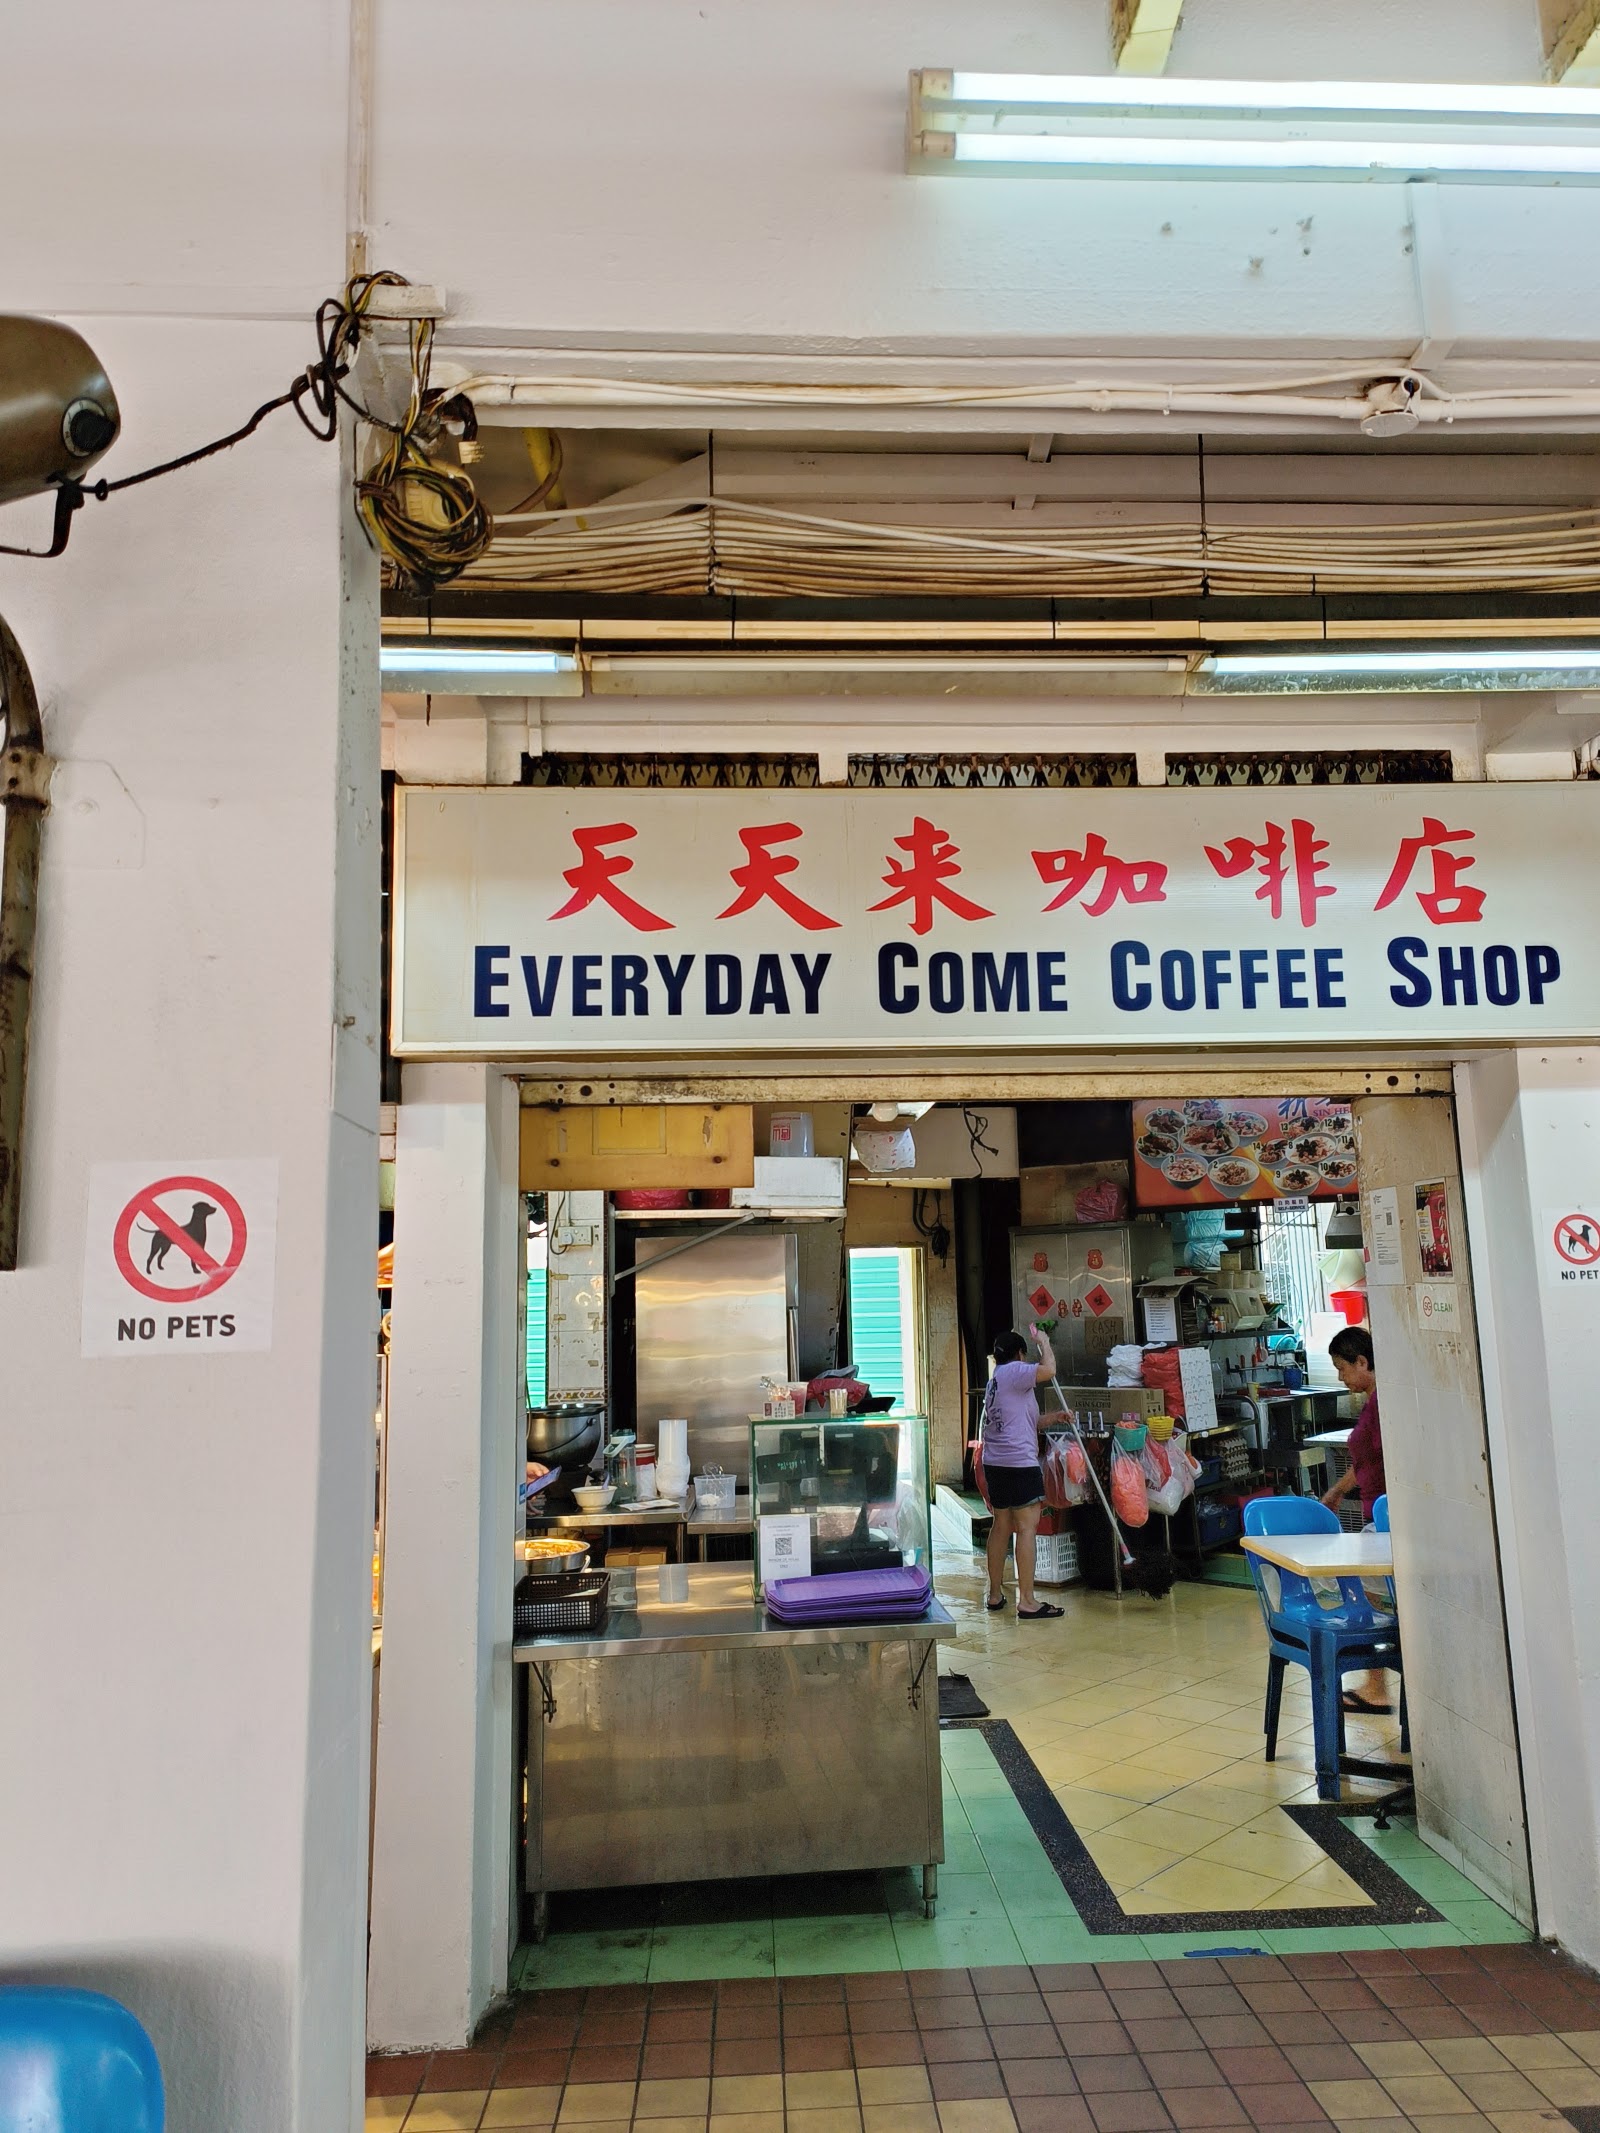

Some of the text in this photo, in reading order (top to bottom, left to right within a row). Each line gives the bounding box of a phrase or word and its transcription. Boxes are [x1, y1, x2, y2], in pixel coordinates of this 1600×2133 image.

[546, 816, 1487, 935] 天天来咖啡店
[473, 935, 1561, 1018] EVERYDAY COME COFFEE SHOP
[1312, 1108, 1331, 1117] SIN
[1280, 1123, 1289, 1131] 13
[1324, 1119, 1333, 1127] 12
[1341, 1135, 1348, 1144] 11
[1252, 1142, 1261, 1150] 14
[1288, 1141, 1294, 1149] 8
[1169, 1155, 1174, 1163] 3
[1213, 1161, 1218, 1169] 2
[1320, 1162, 1329, 1171] 10
[1275, 1170, 1281, 1179] 9
[1561, 1269, 1600, 1281] NO PET
[1433, 1302, 1453, 1313] CLEAN
[118, 1314, 236, 1341] NO PETS
[1092, 1320, 1116, 1335] CASH
